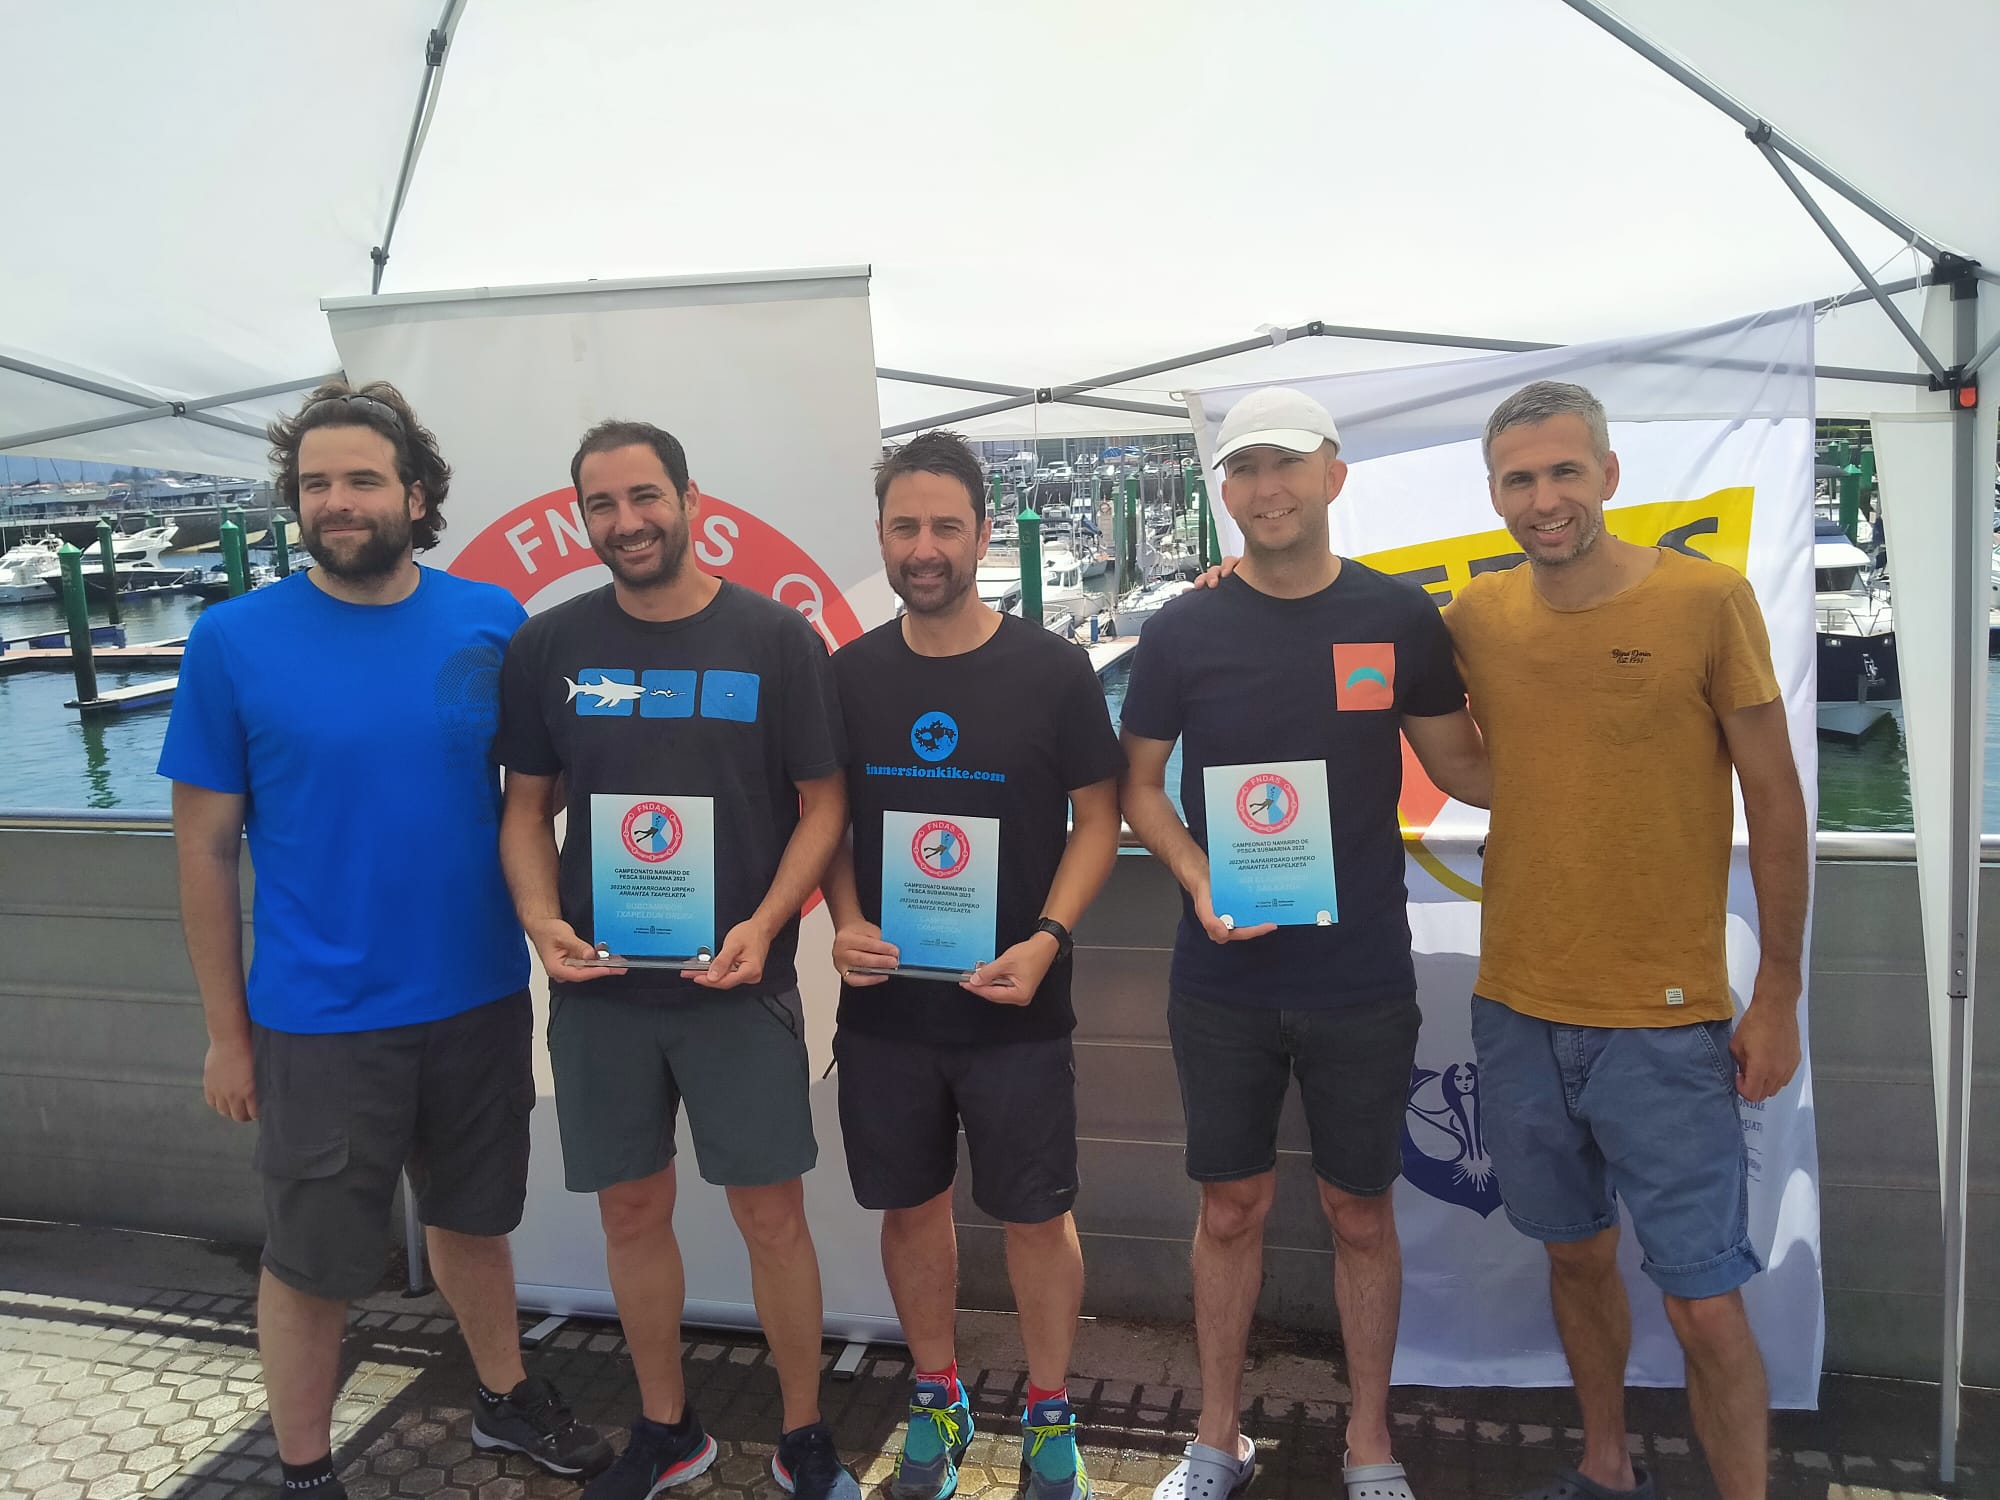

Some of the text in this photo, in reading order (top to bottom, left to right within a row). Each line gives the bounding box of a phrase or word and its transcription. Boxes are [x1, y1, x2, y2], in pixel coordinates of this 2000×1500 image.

[504, 500, 740, 575] FNS
[865, 762, 1006, 783] inmersionkike.com
[1250, 775, 1281, 785] FNDAS
[637, 803, 667, 814] FNDAS
[927, 823, 955, 833] FNDAS
